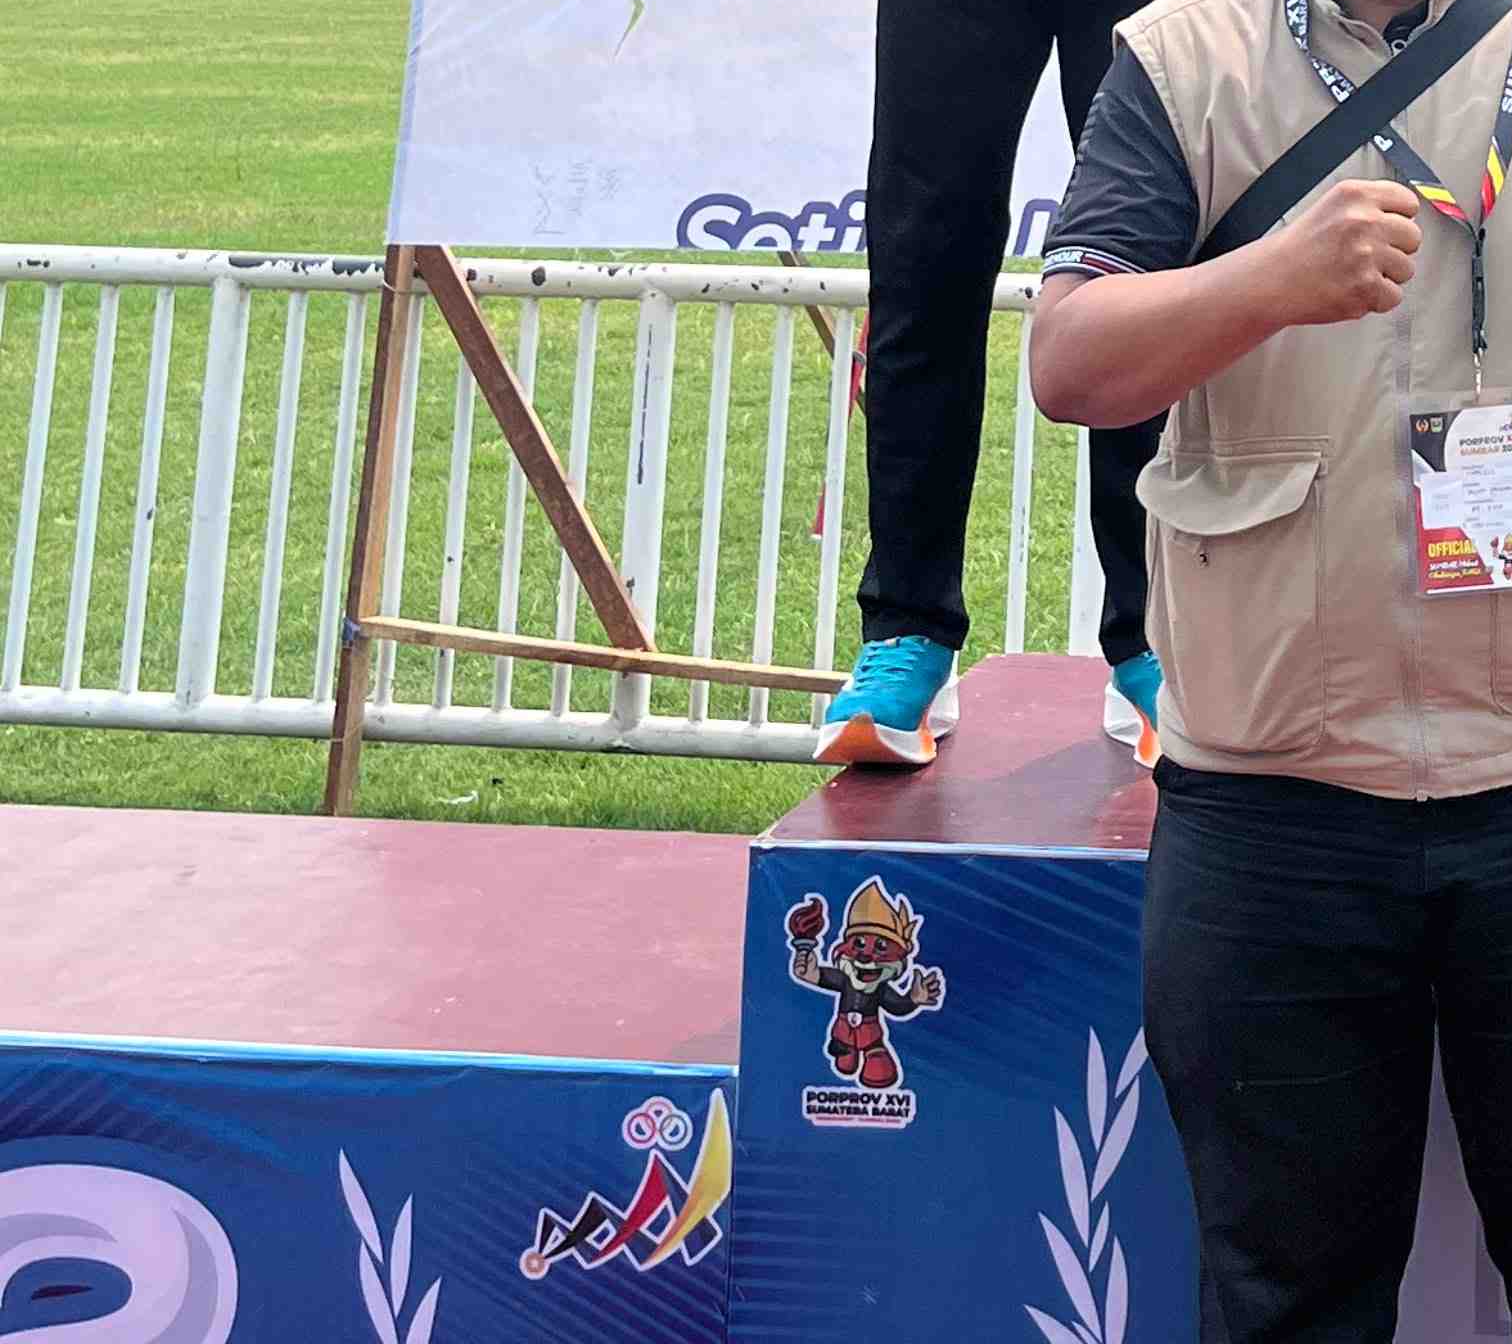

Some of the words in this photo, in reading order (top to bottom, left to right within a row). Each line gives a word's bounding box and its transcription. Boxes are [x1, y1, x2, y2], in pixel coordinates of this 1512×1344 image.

[806, 1091, 881, 1105] PORPROV
[885, 1093, 911, 1107] XVI
[806, 1104, 870, 1117] SUMATERA
[871, 1106, 911, 1118] BARAT
